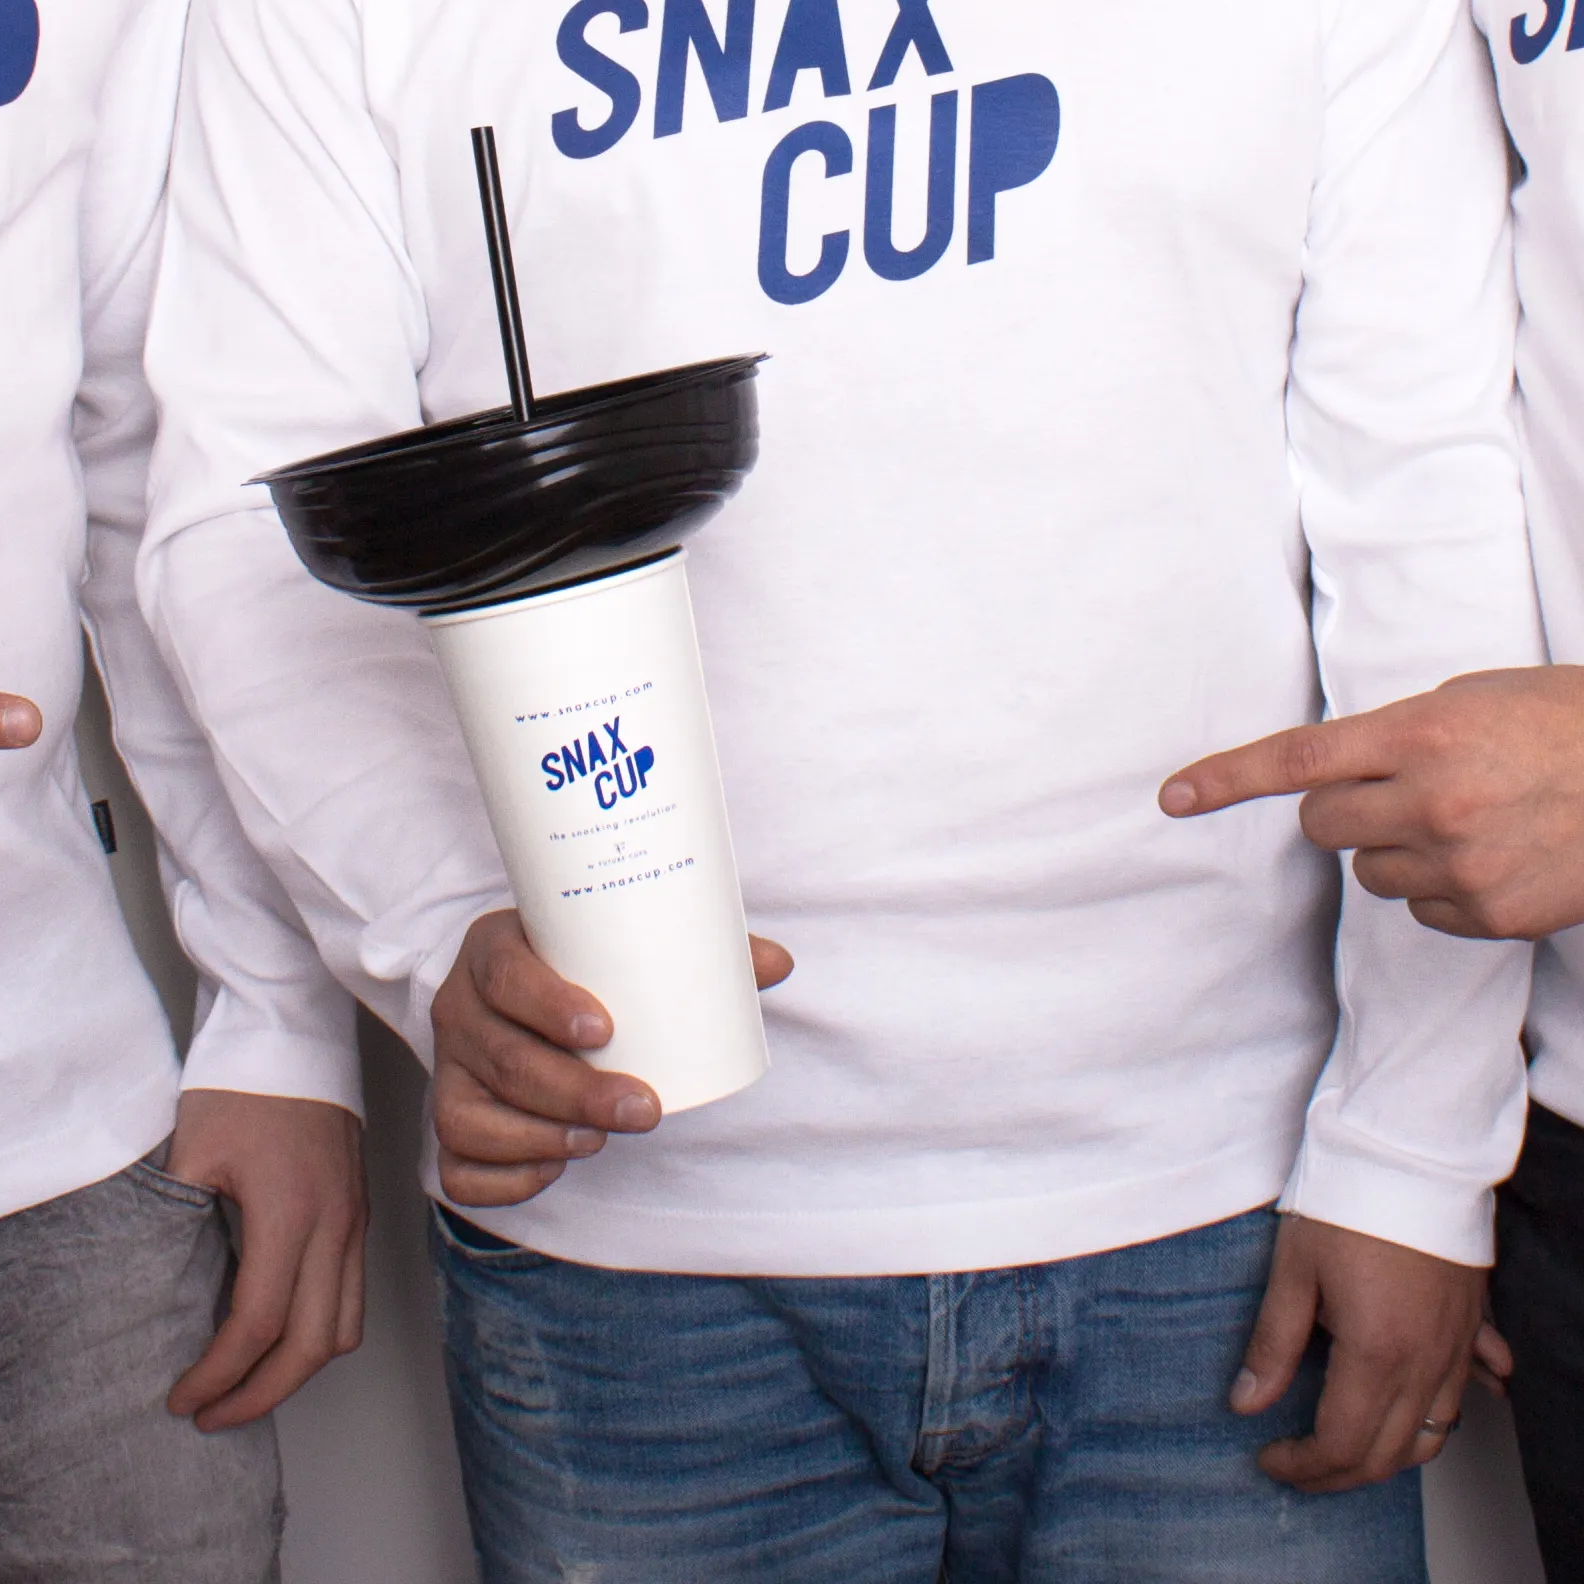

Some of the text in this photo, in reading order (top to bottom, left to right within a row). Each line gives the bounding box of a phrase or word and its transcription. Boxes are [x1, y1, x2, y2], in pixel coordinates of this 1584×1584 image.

[758, 74, 1062, 307] CUP
[514, 680, 653, 723] www.snaxcup.com
[540, 715, 628, 792] SNAX
[593, 744, 655, 811] CUP
[561, 857, 694, 898] www.snaxcup.com
